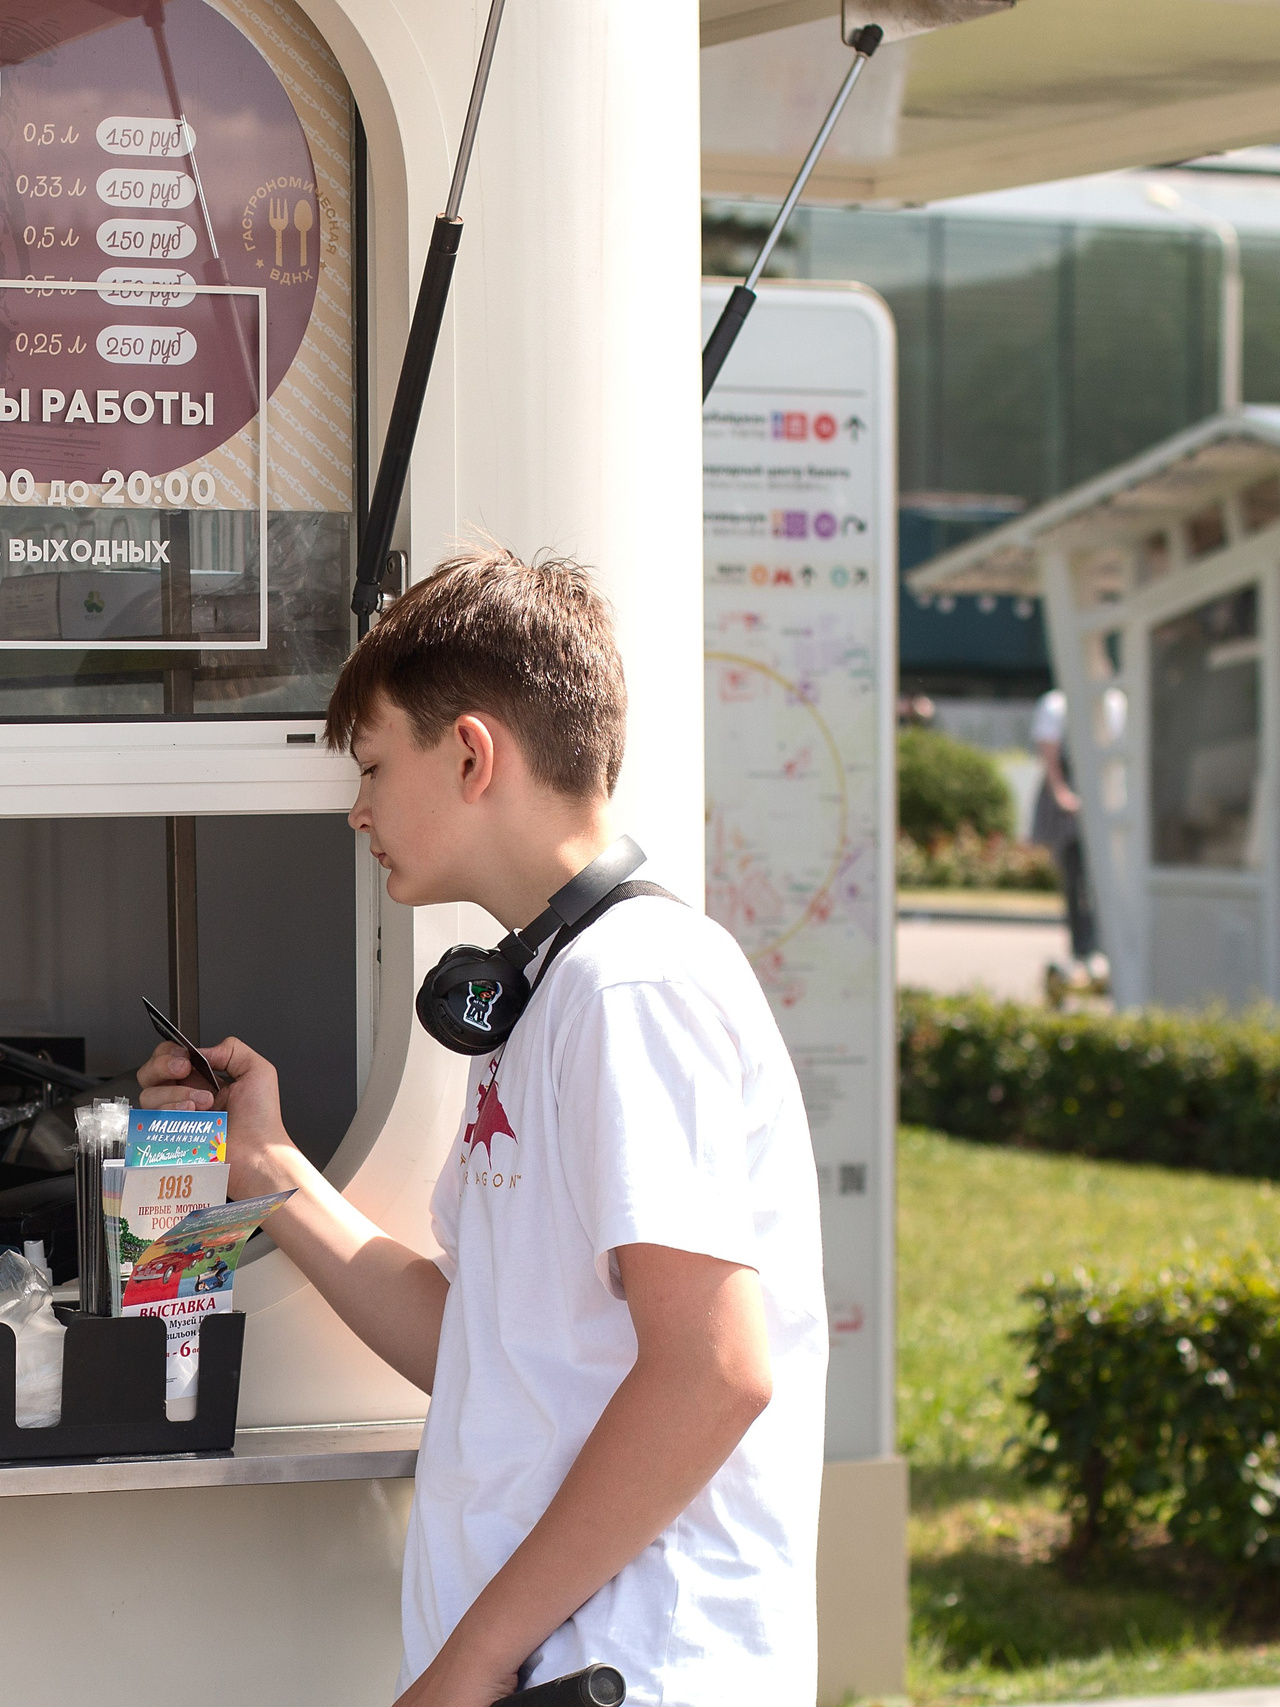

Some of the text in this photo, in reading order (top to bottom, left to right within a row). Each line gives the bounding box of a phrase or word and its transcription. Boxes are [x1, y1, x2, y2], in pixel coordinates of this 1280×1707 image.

[23, 123, 80, 147] 0,5 л
[106, 123, 184, 156] 150 руб
[16, 174, 87, 198] 0,33 л
[106, 173, 187, 208] 150 руб
[23, 225, 80, 249] 0,5 л
[106, 223, 187, 258] 150 руб
[270, 268, 313, 286] ВДНХ
[15, 332, 87, 356] 0,25 л
[106, 330, 187, 365] 250 руб
[42, 389, 215, 426] РАБОТЫ
[48, 480, 89, 507] до
[101, 470, 216, 506] 20:00
[9, 539, 170, 566] ВЫХОДНЫХ
[148, 1120, 214, 1134] МАШИНКИ
[157, 1174, 193, 1200] 1913
[138, 1205, 171, 1216] ПЕРВЫЕ
[140, 1297, 216, 1318] ВЫСТАВКА
[169, 1316, 197, 1329] Музей
[180, 1340, 191, 1357] 6
